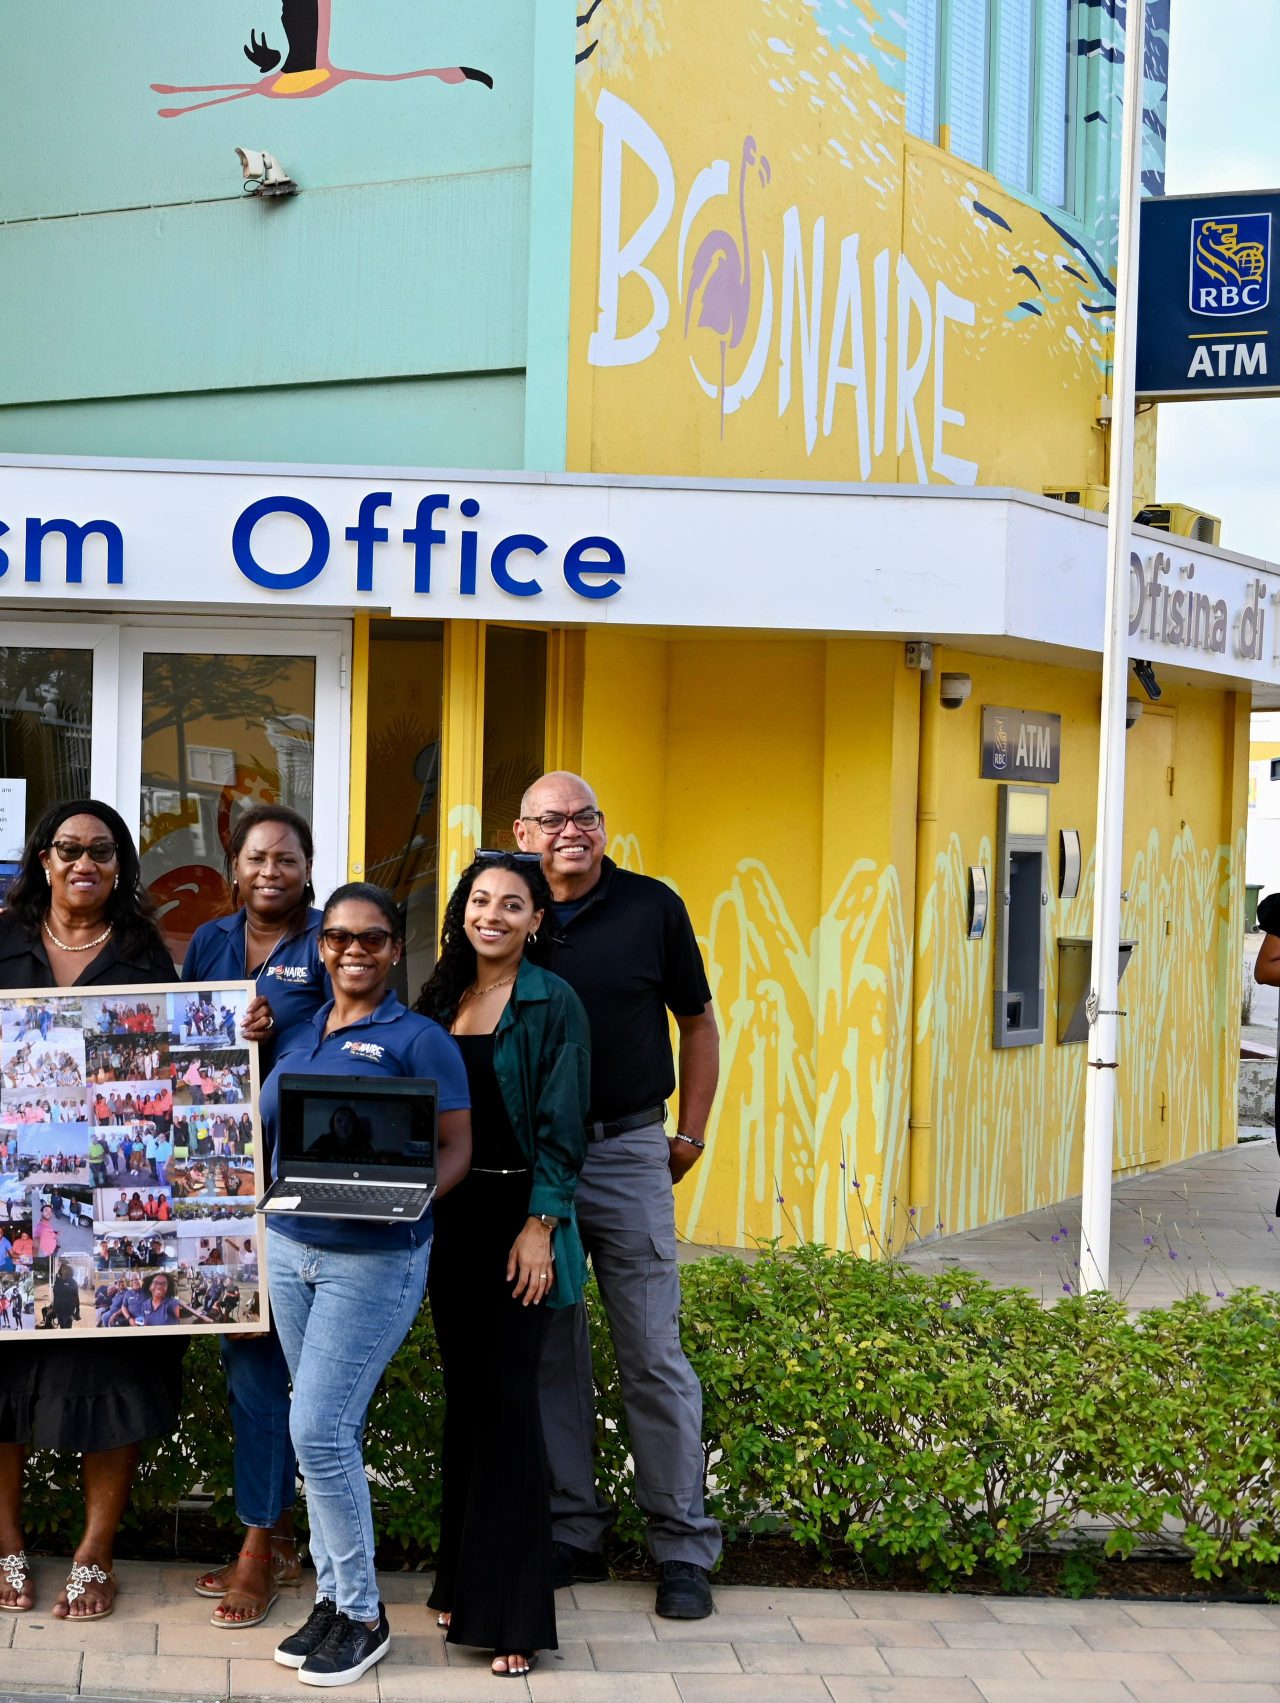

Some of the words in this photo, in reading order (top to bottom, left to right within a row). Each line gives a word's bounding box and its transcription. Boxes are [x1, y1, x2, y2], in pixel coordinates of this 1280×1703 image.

[587, 87, 979, 486] BONAIRE
[1199, 284, 1261, 309] RBC
[1186, 341, 1268, 379] ATM
[230, 490, 627, 601] Office
[1238, 578, 1267, 661] di
[994, 753, 1006, 765] RBC
[1015, 723, 1051, 769] ATM
[266, 965, 308, 978] BONAIRE
